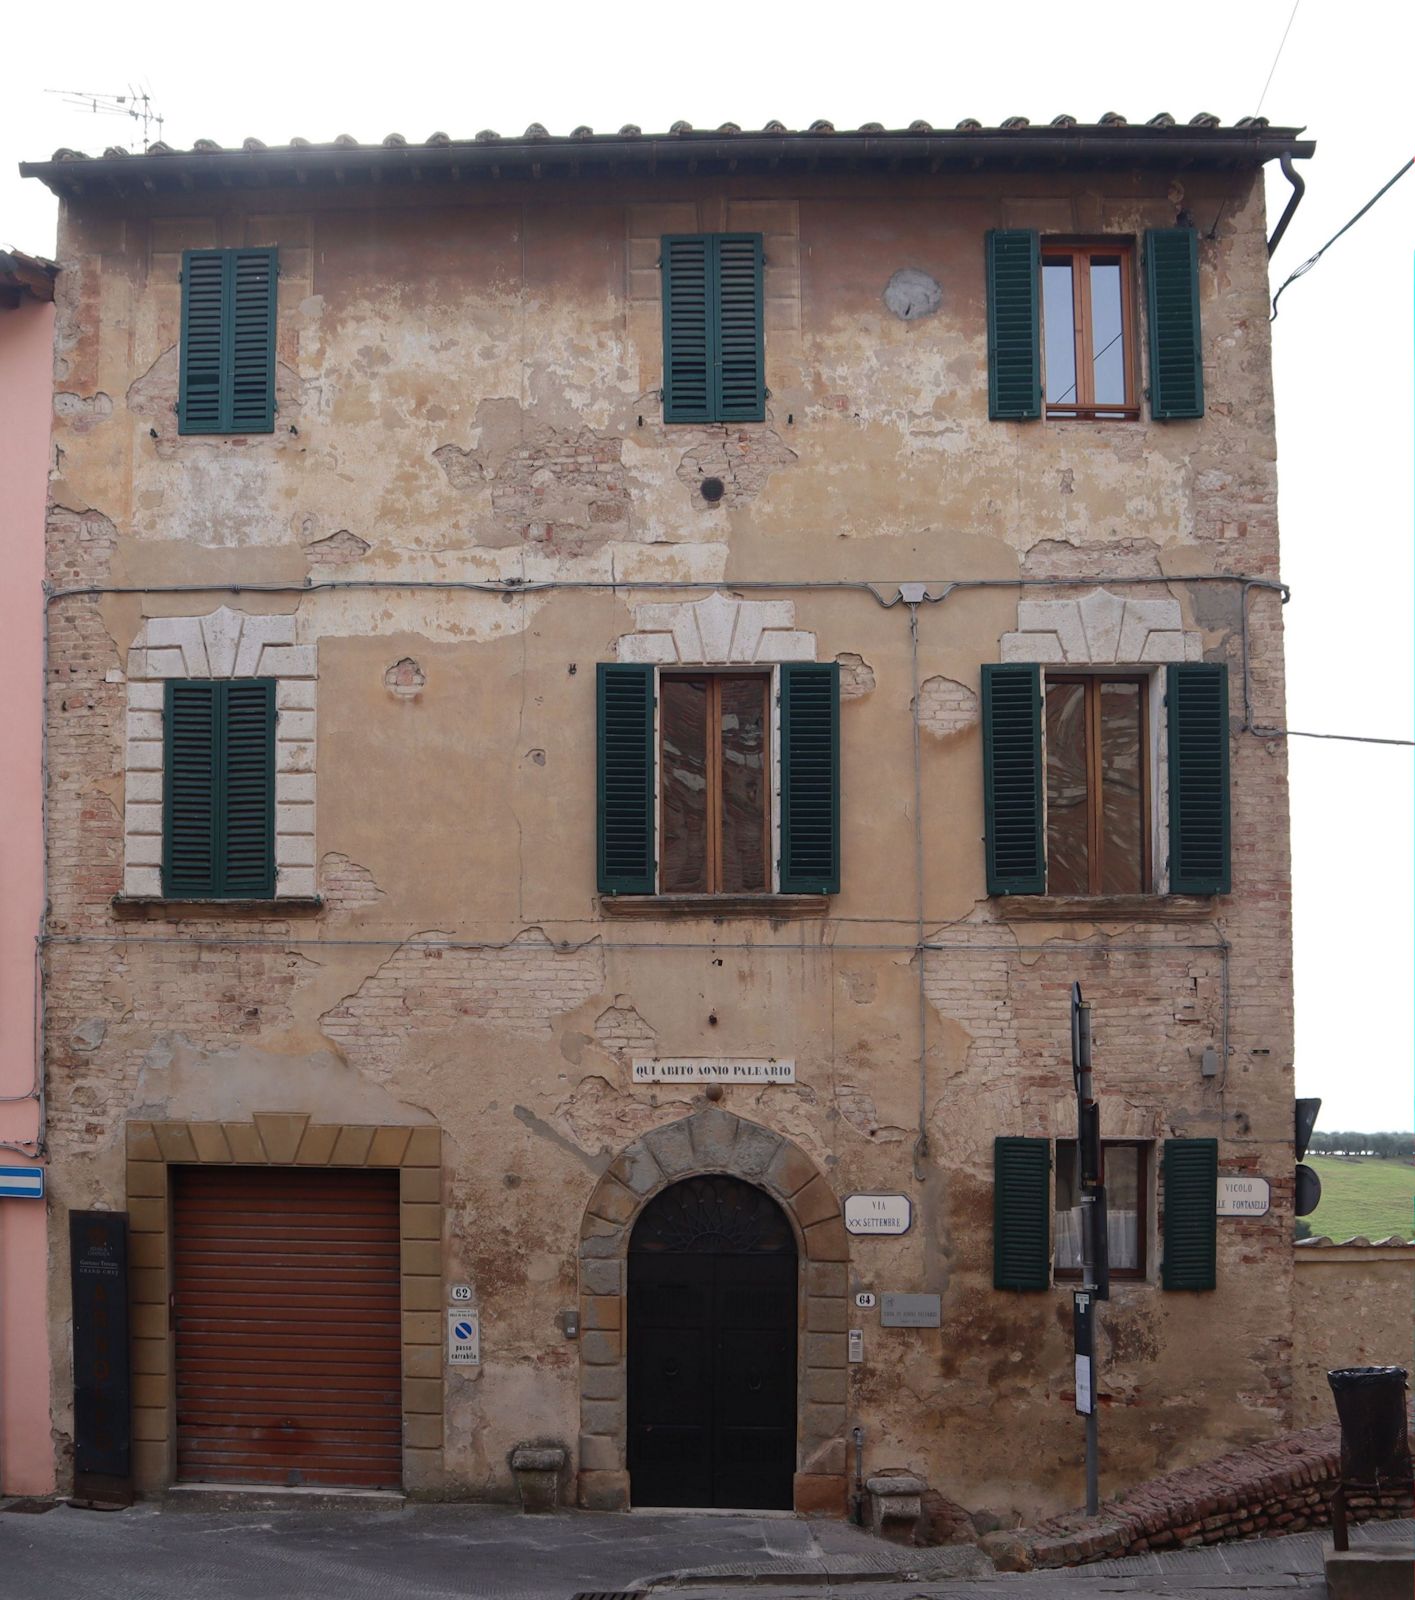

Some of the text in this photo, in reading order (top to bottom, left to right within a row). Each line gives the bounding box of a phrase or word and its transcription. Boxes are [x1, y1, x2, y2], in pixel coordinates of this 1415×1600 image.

[636, 1066, 655, 1078] QUI
[697, 1066, 729, 1076] AONIO
[733, 1066, 792, 1076] PALEARIO
[1225, 1184, 1253, 1193] VICOLO
[872, 1200, 886, 1211] VIA
[1232, 1200, 1268, 1210] FONTANELLE
[848, 1218, 901, 1228] XX SETTEMBRE
[455, 1288, 468, 1299] 62
[859, 1295, 871, 1305] 64
[455, 1345, 472, 1353] passo
